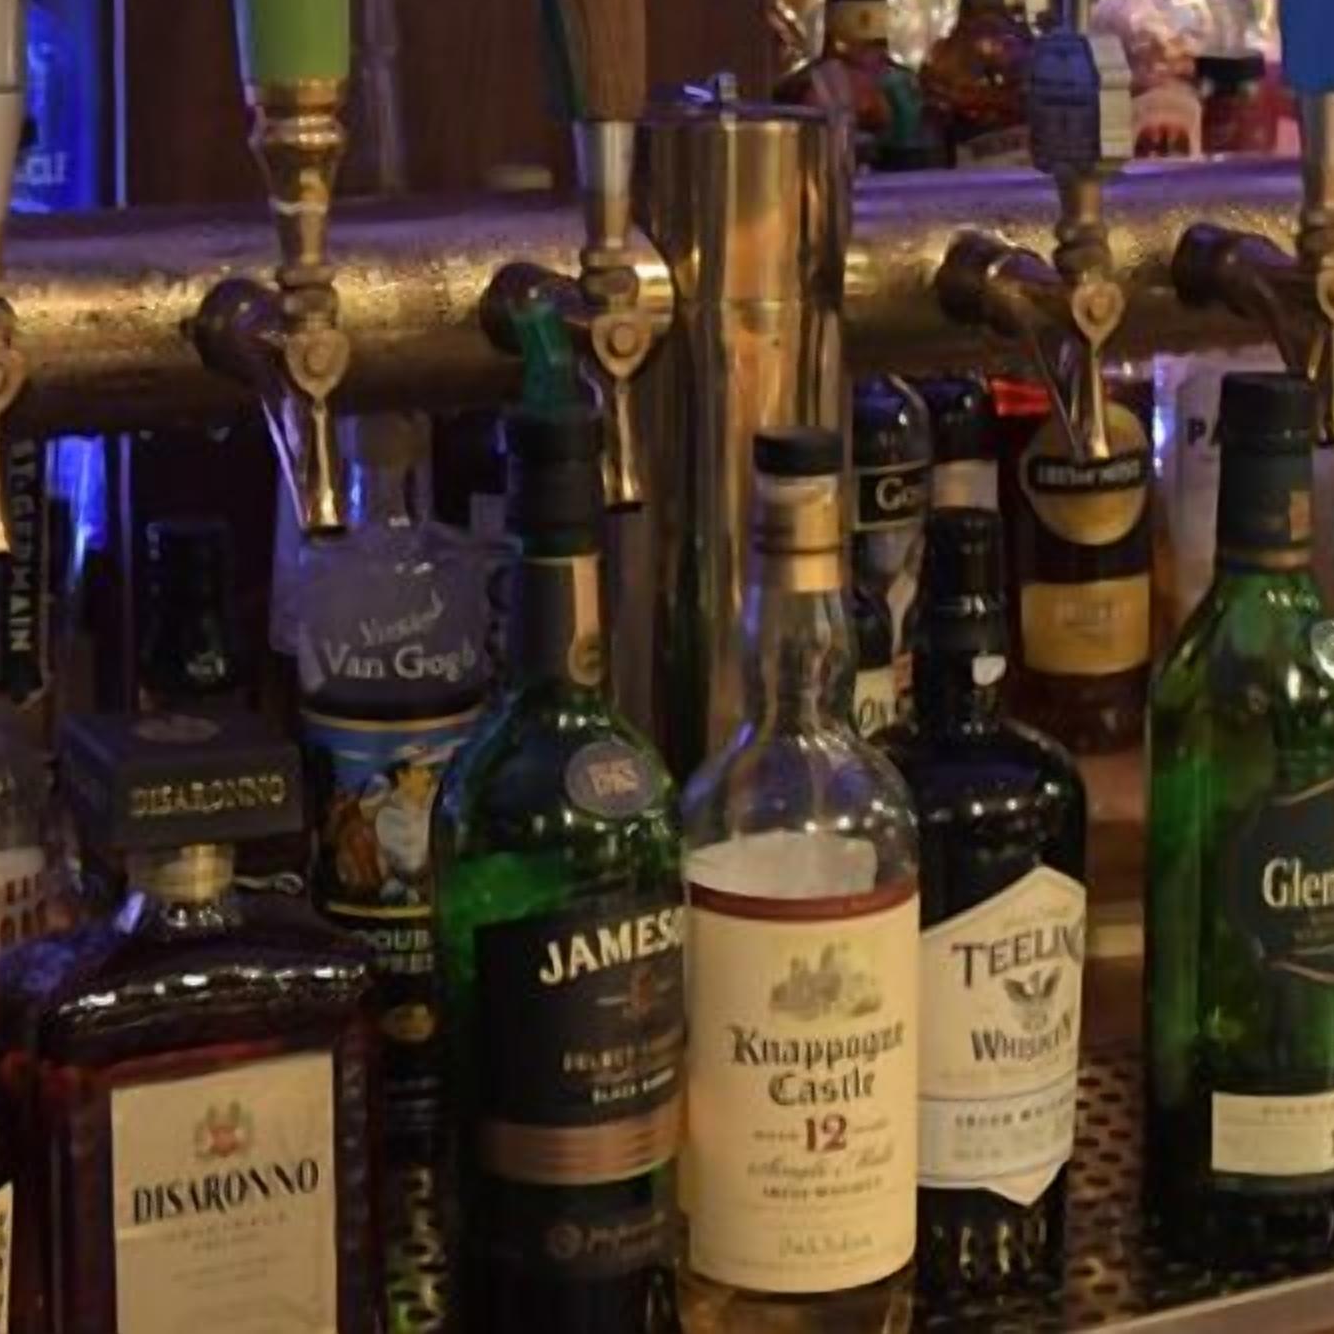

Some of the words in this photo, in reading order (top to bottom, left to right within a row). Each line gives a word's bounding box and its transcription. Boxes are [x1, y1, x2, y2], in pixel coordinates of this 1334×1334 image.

[321, 636, 386, 680] Van
[768, 1065, 876, 1107] Castle
[805, 1112, 848, 1154] 12
[132, 1157, 320, 1226] DISARONNO
